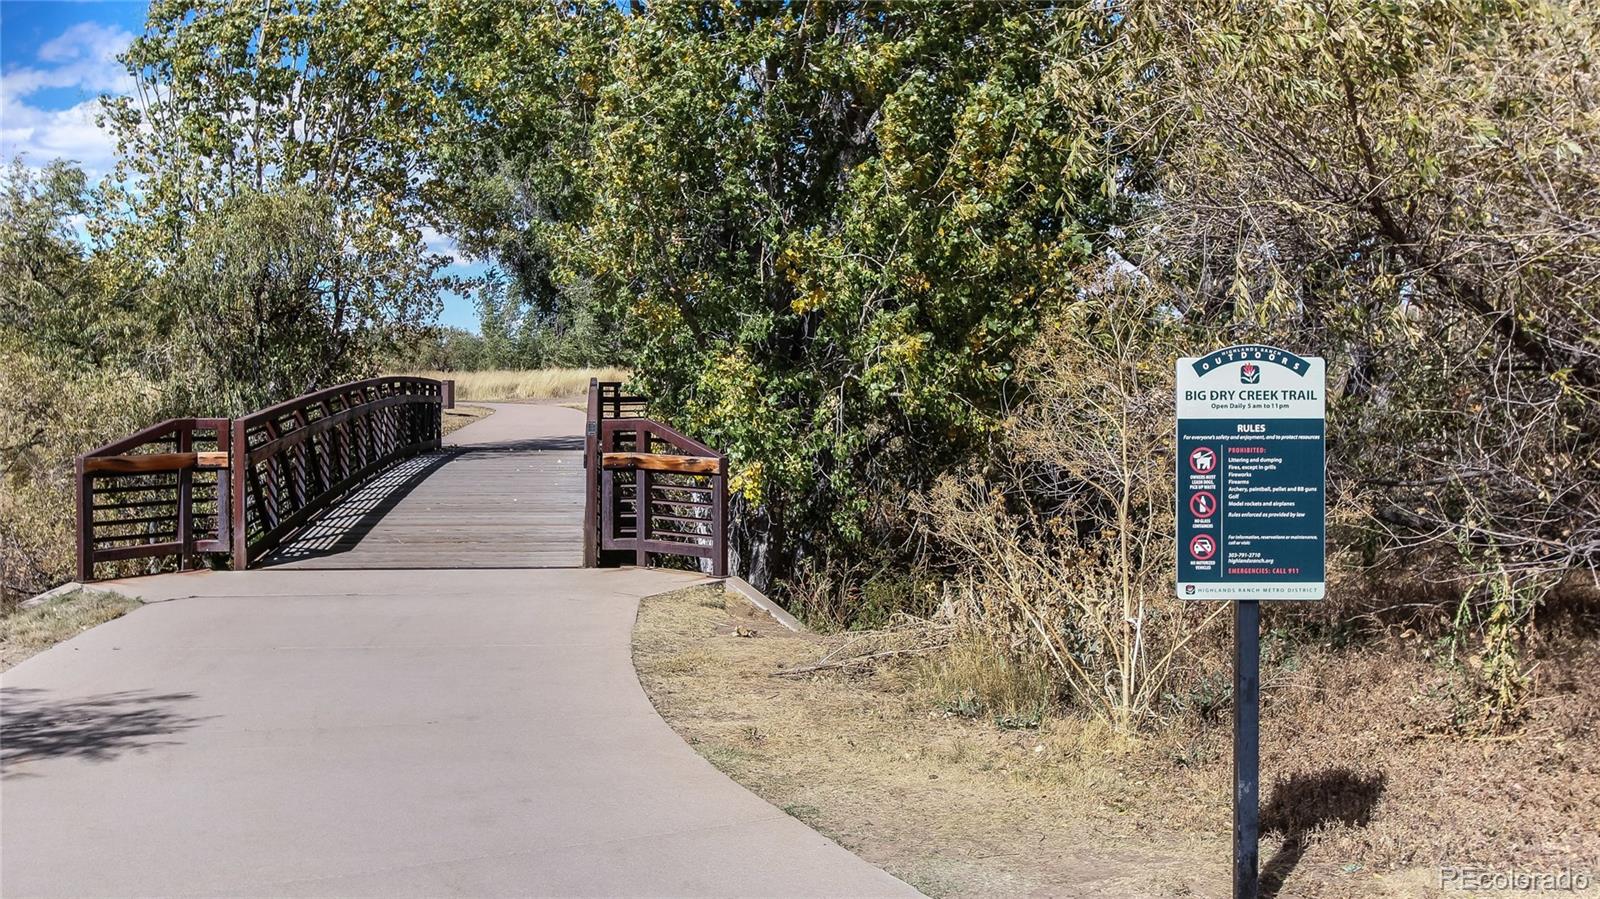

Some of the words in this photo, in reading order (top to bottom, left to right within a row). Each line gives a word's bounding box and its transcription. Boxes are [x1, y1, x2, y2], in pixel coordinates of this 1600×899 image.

[1221, 347, 1258, 355] HIGHLANDS
[1202, 351, 1300, 370] OUTDOORS
[1185, 390, 1206, 400] BIG
[1210, 390, 1235, 400] DRY
[1238, 390, 1279, 400] CREEK
[1281, 390, 1317, 400] TRAIL
[1237, 424, 1266, 432] RULES
